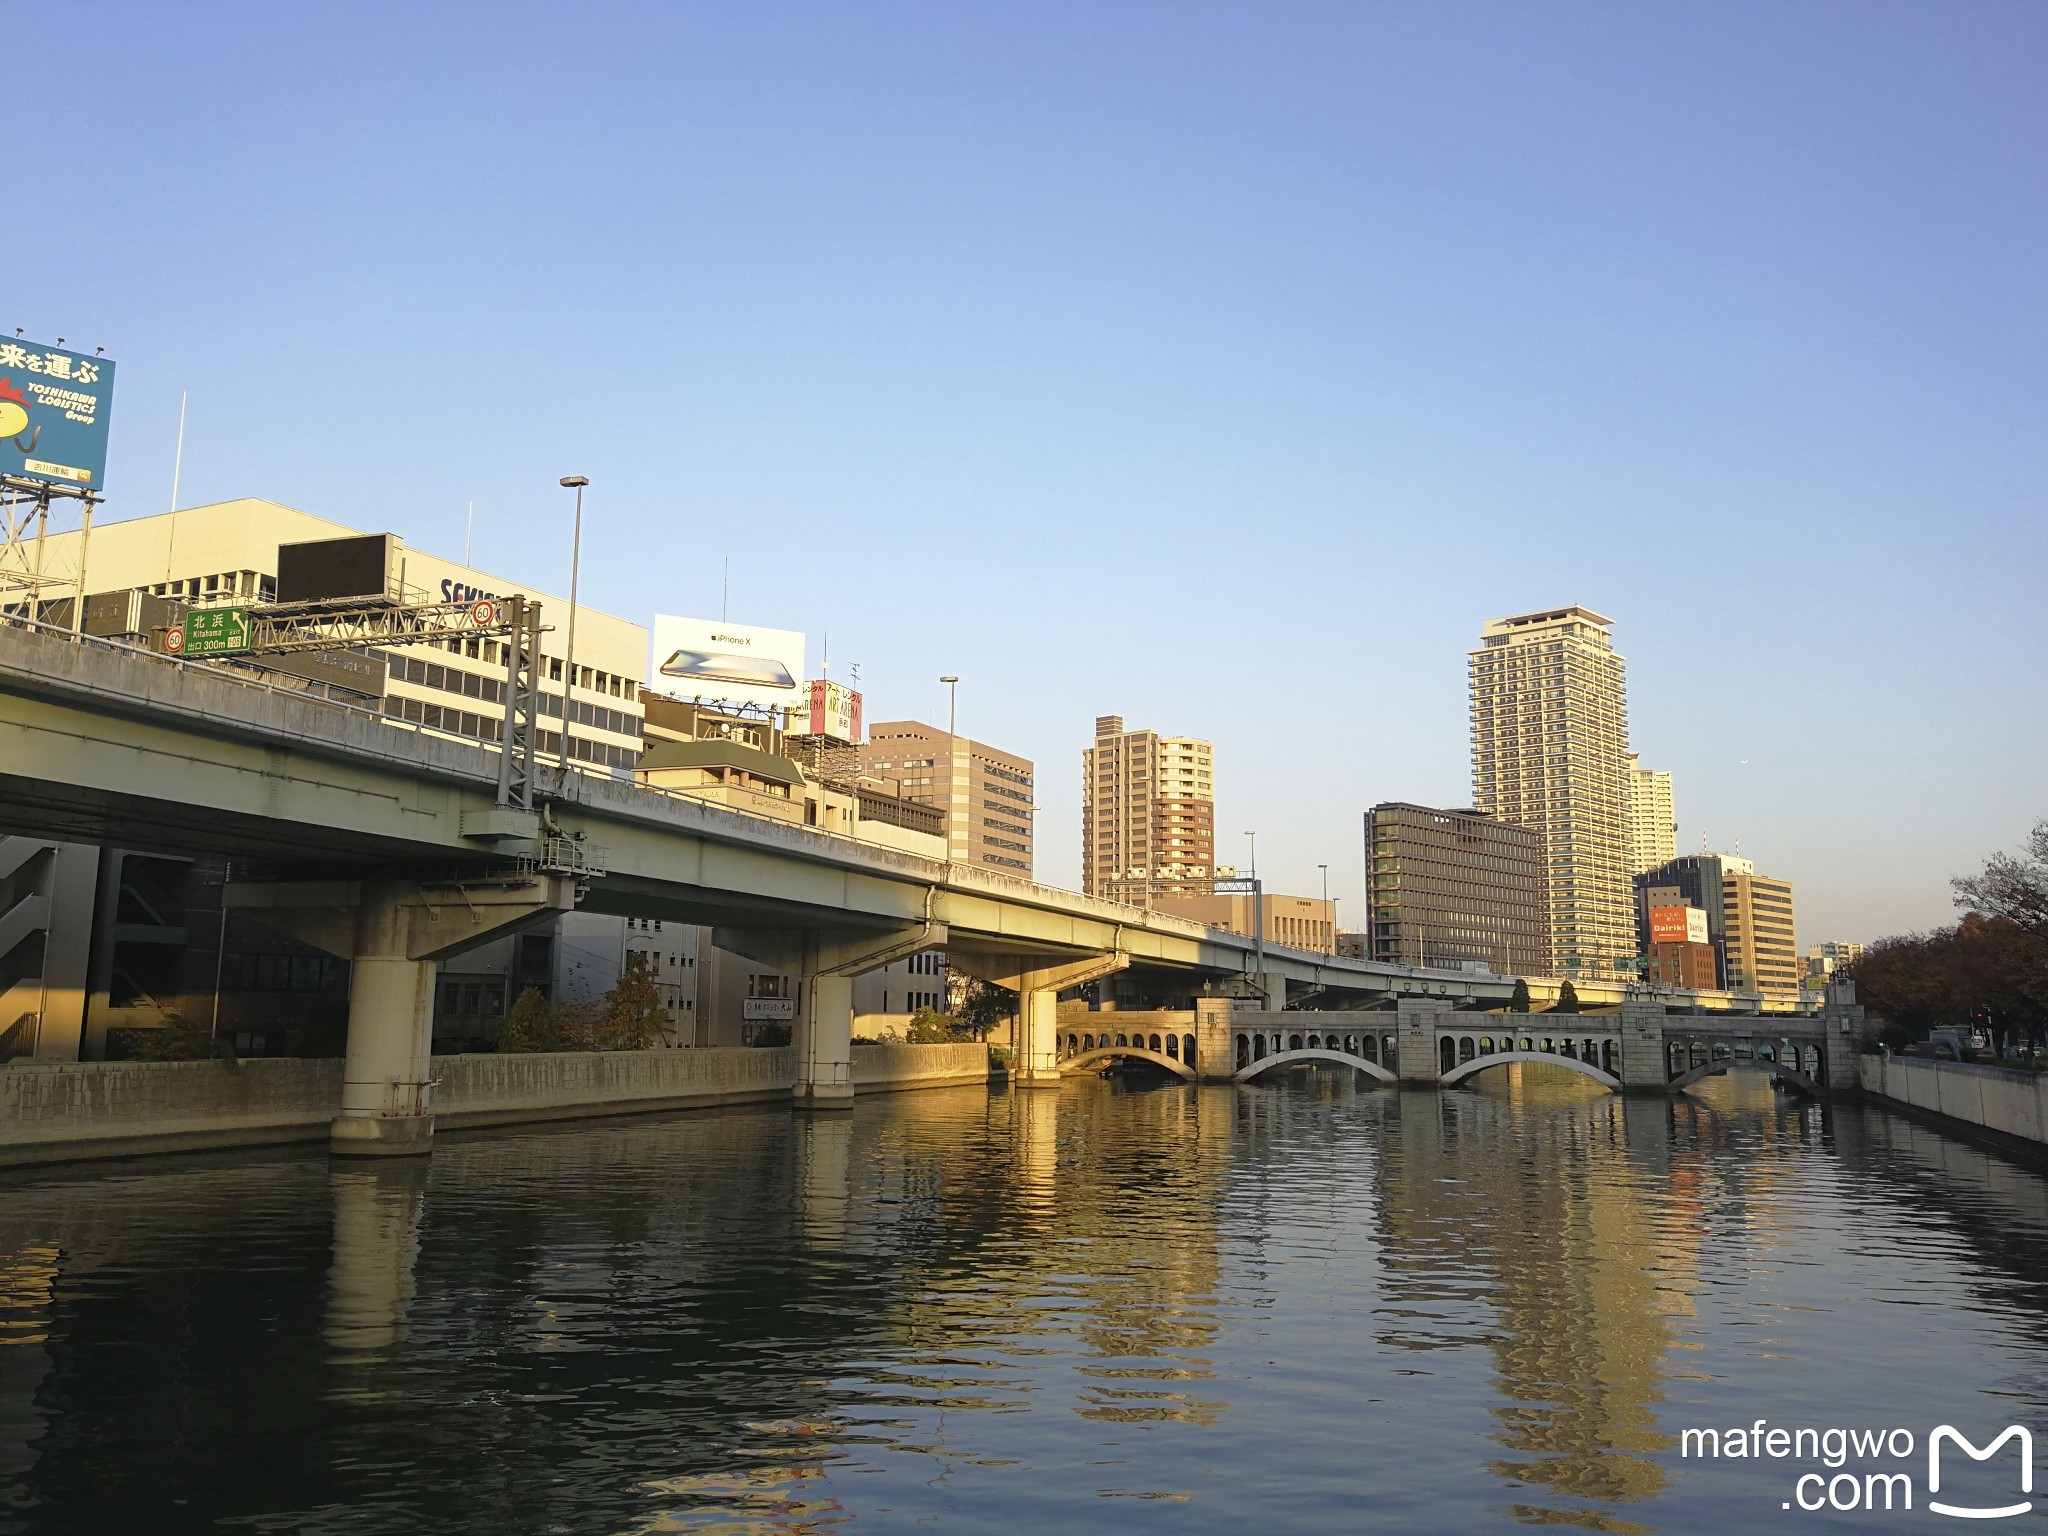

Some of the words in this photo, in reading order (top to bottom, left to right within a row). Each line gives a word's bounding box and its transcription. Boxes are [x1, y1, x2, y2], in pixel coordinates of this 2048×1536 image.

[37, 395, 96, 414] LOGISTICS
[65, 411, 95, 425] Group
[477, 607, 489, 619] 60
[194, 613, 224, 629] 北浜
[169, 634, 180, 645] 60
[193, 629, 222, 638] Kitahama
[188, 641, 202, 651] 出口
[203, 640, 226, 650] 300m
[717, 634, 745, 645] iPhone
[745, 638, 751, 646] X
[1653, 924, 1685, 932] Dairiki
